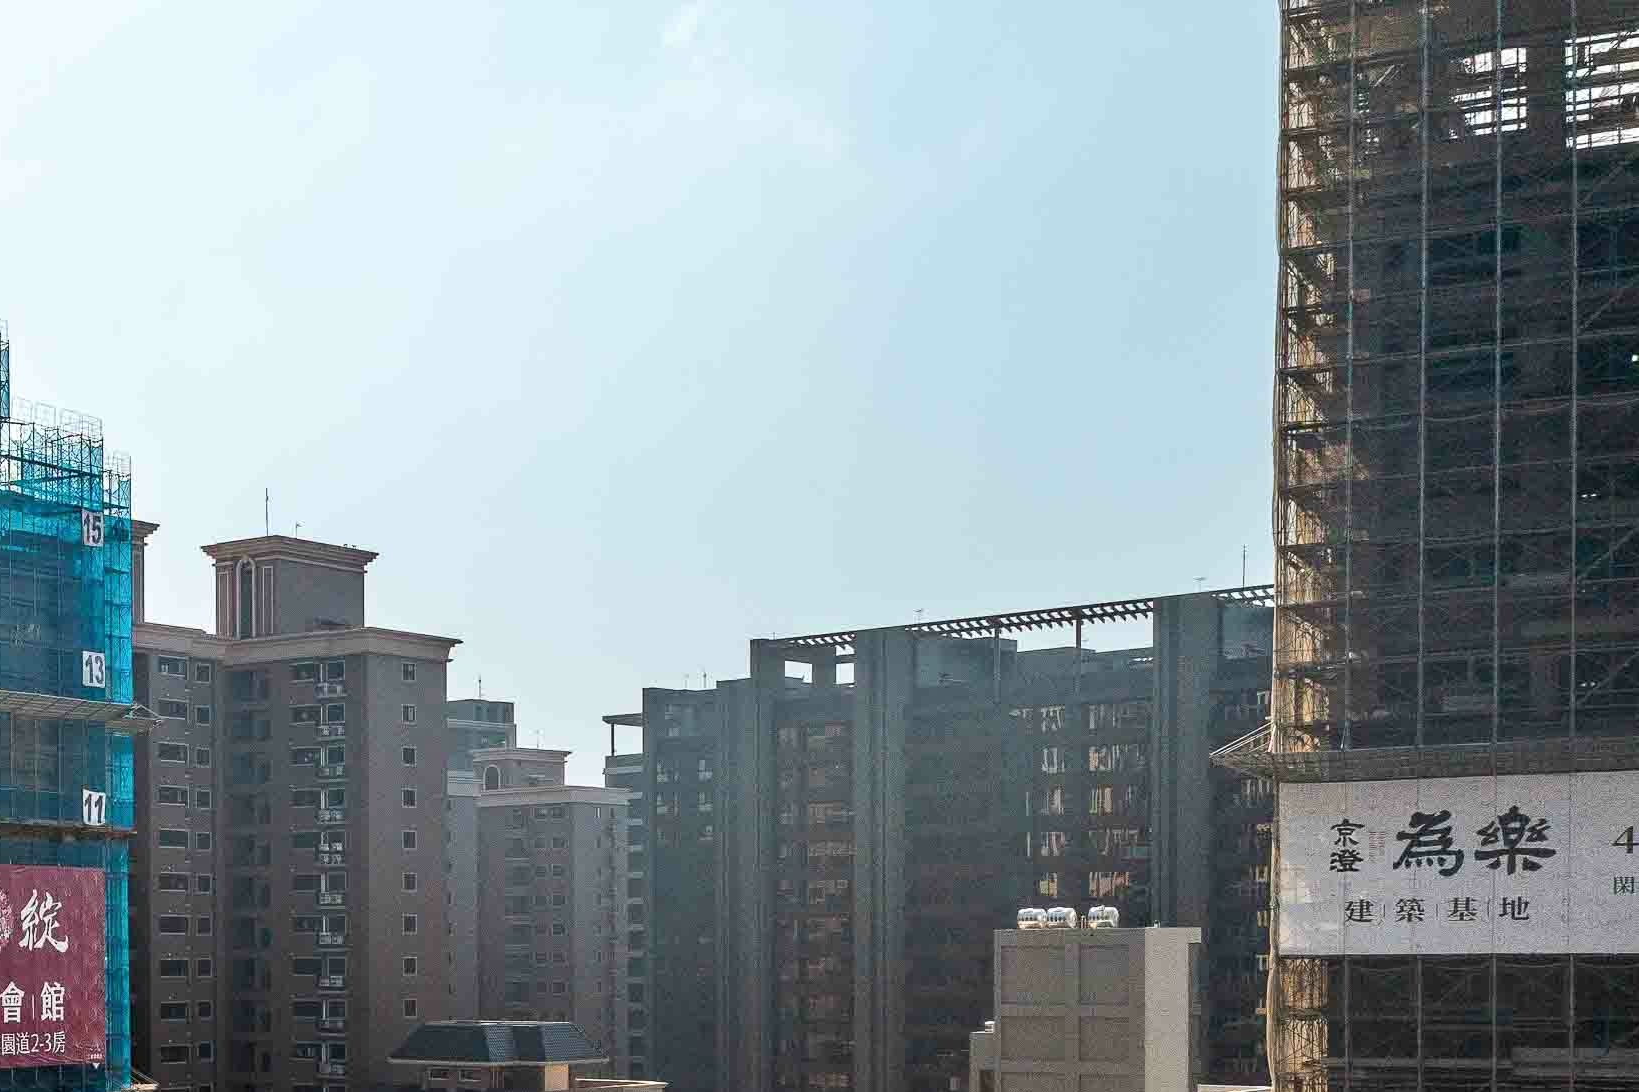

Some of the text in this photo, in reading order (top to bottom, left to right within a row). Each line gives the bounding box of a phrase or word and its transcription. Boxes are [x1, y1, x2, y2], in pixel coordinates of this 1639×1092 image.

[83, 513, 103, 544] 15
[84, 655, 104, 685] 13
[84, 794, 105, 823] 11
[1393, 804, 1558, 877] 為樂
